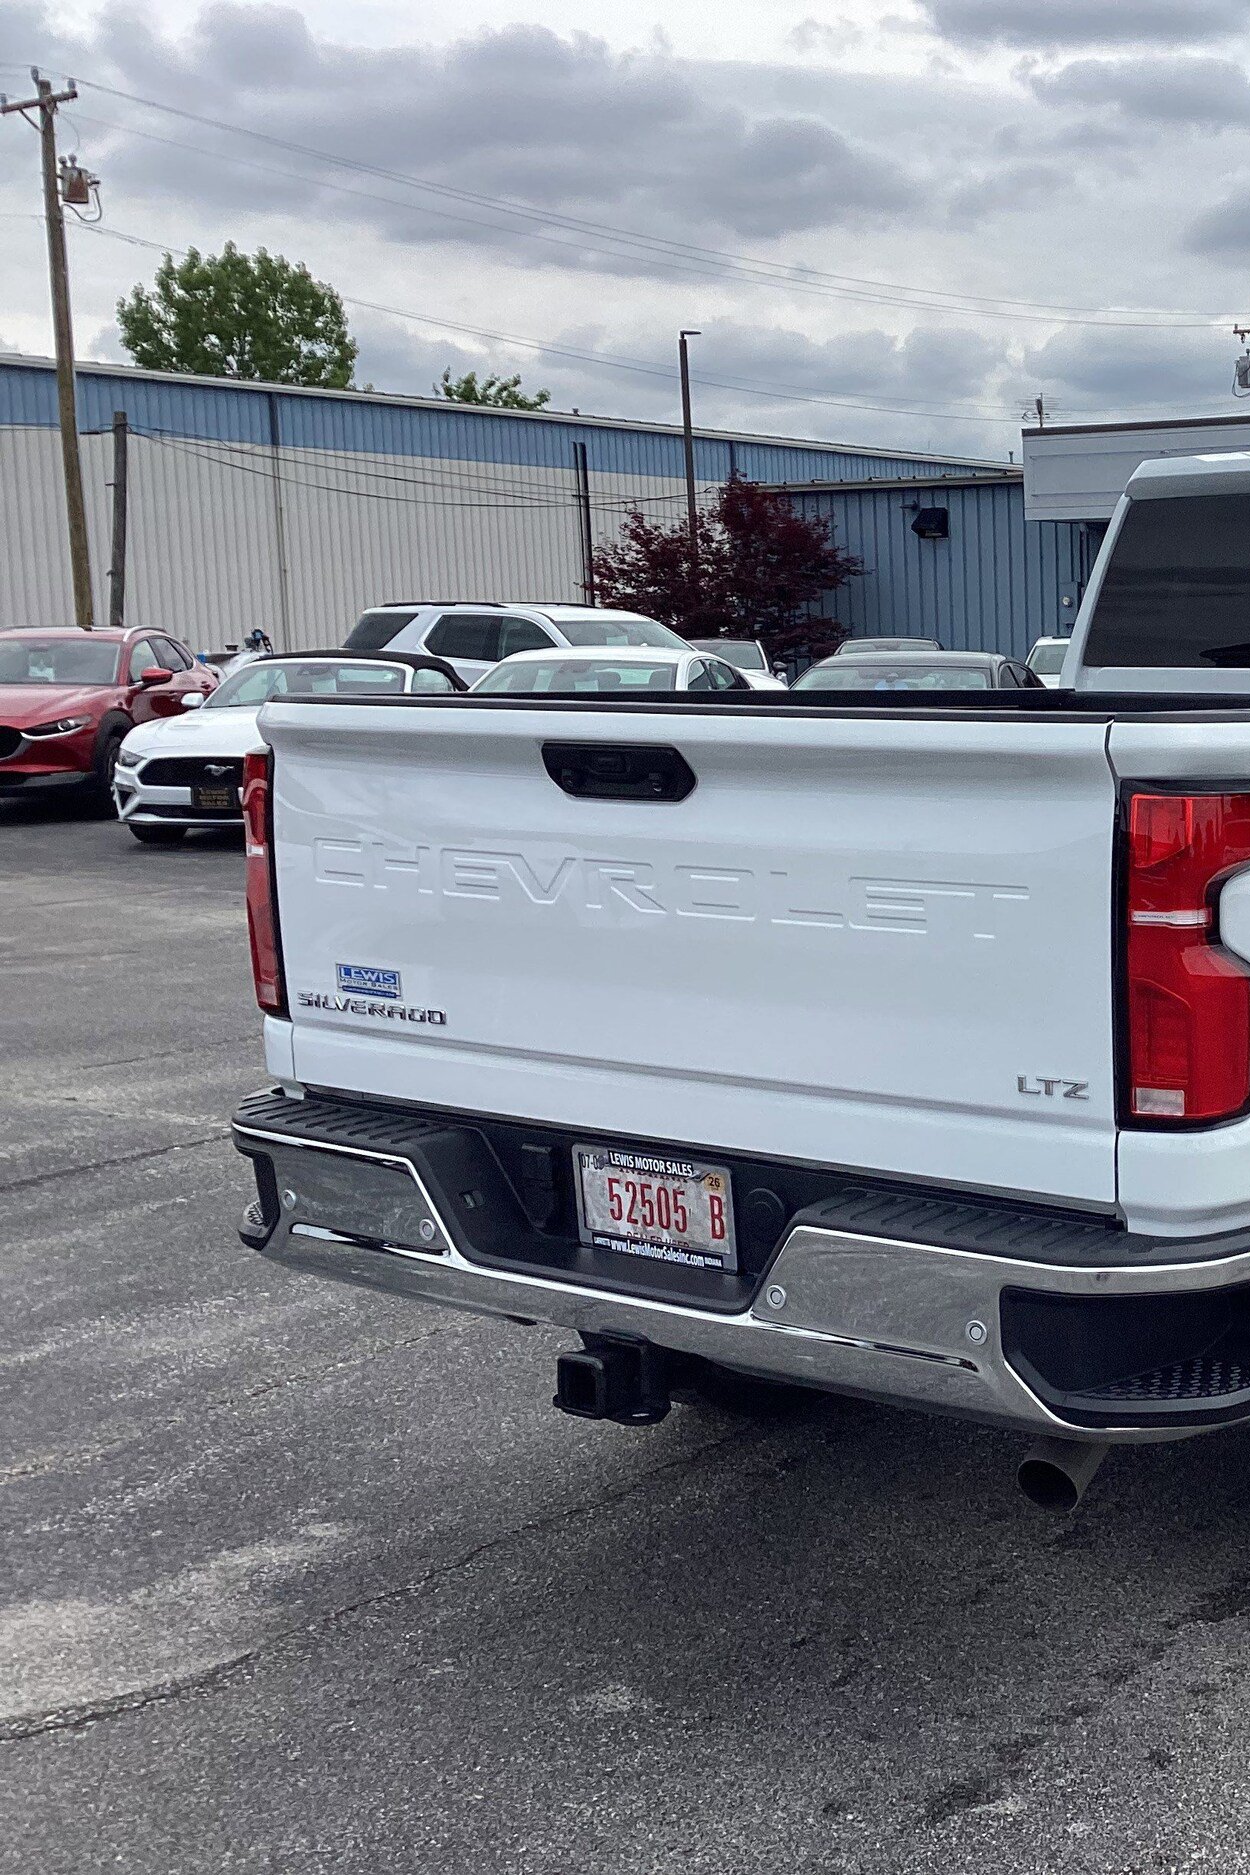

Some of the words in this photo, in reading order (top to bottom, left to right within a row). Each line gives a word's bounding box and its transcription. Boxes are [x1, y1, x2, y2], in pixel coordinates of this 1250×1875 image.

[313, 837, 1030, 938] CHEVROLET
[340, 967, 395, 983] LEWIS
[297, 989, 447, 1026] SILVERADO
[1017, 1075, 1089, 1100] LTZ
[609, 1152, 634, 1168] LEWIS
[635, 1157, 666, 1173] MOTOR
[666, 1162, 693, 1177] SALES
[607, 1177, 688, 1233] 52505
[709, 1194, 725, 1240] B
